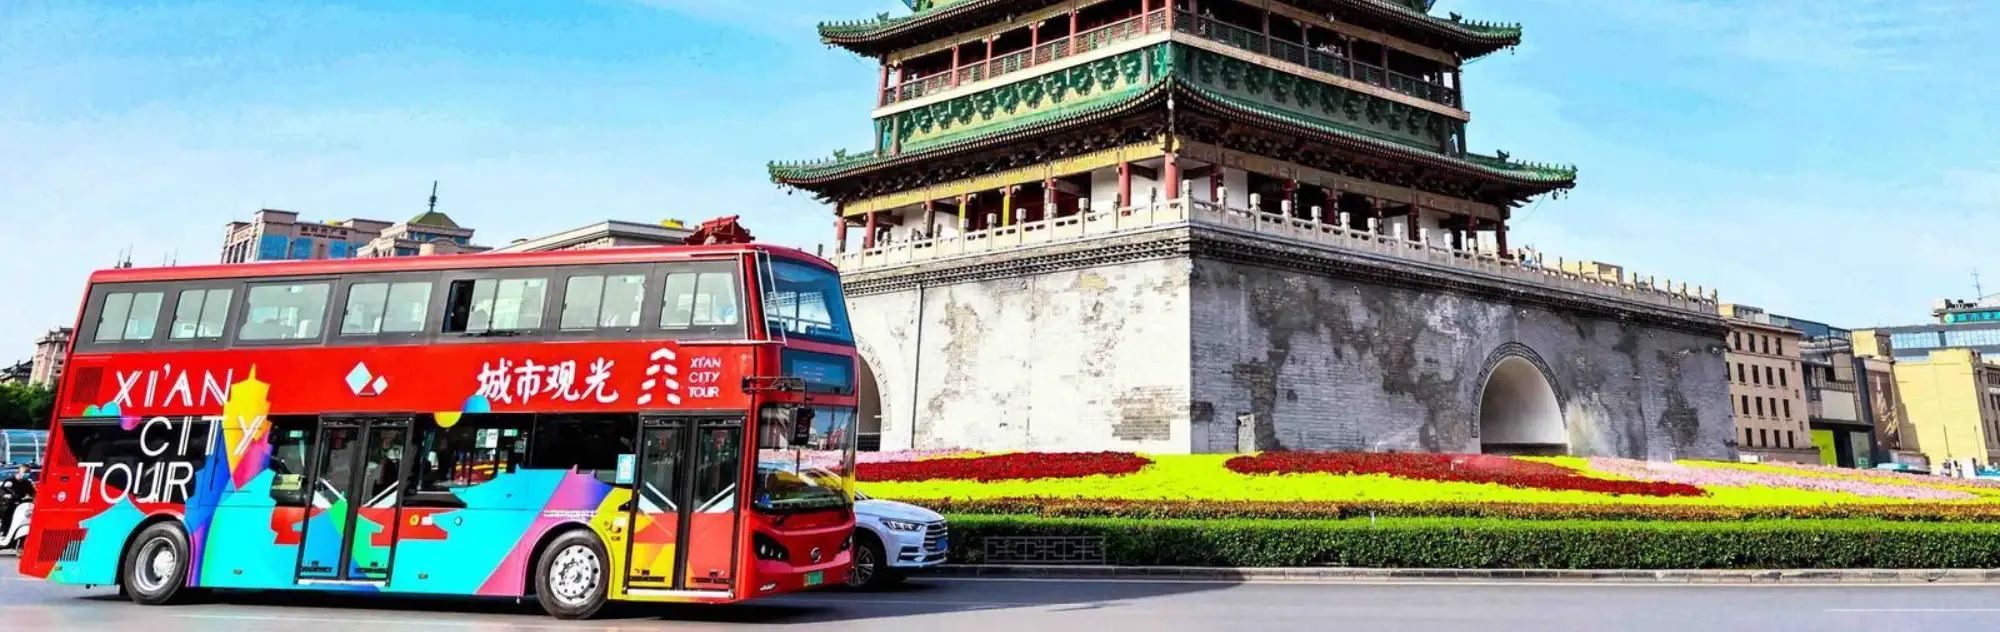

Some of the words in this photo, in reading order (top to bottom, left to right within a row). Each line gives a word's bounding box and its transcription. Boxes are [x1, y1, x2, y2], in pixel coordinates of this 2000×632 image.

[115, 363, 233, 407] XI'AN
[478, 357, 619, 405] 城市观光
[688, 386, 720, 398] TOUR
[689, 372, 720, 383] CITY
[140, 416, 266, 456] CITY
[78, 461, 194, 503] TOUR
